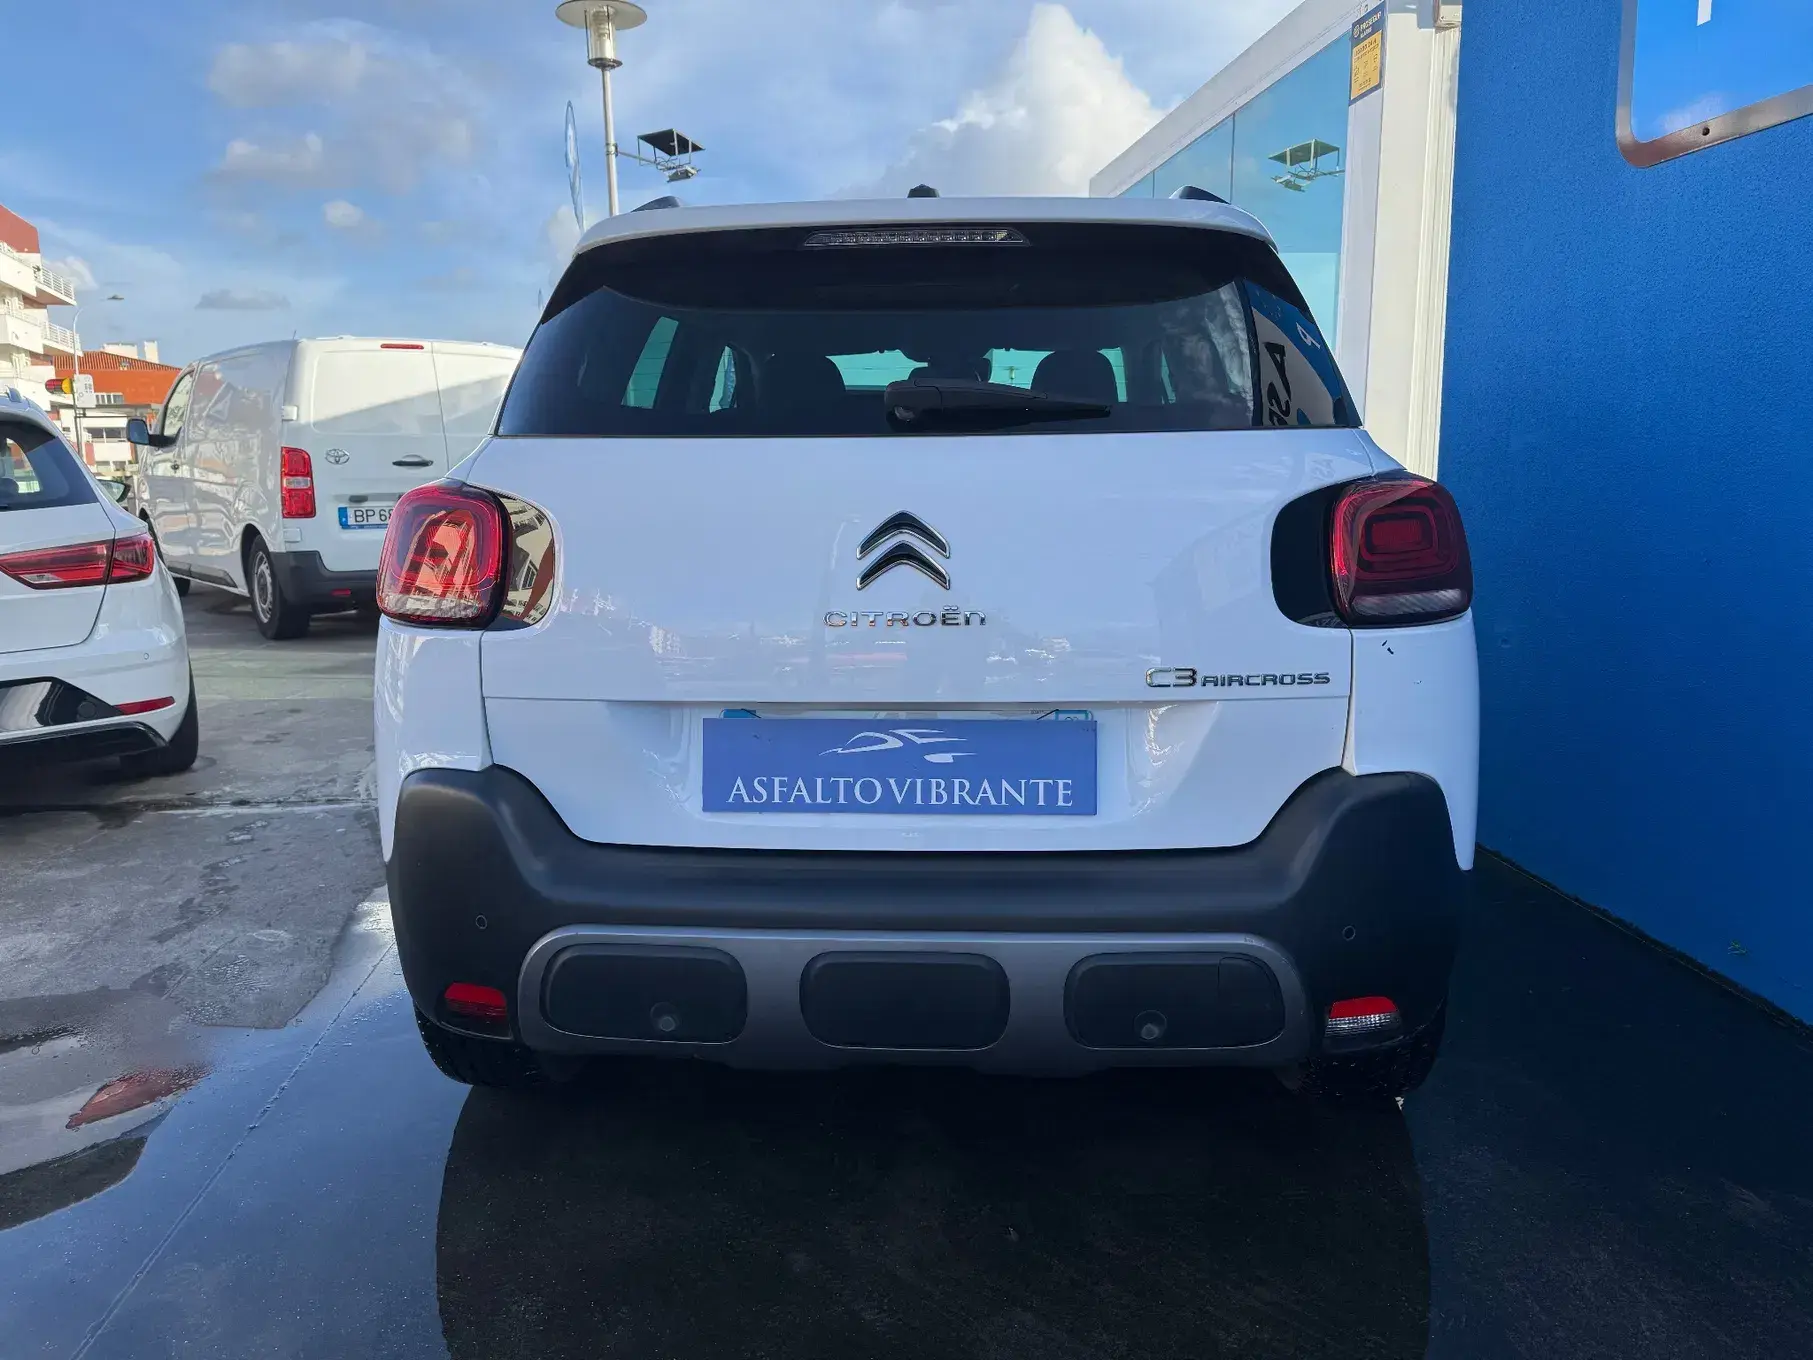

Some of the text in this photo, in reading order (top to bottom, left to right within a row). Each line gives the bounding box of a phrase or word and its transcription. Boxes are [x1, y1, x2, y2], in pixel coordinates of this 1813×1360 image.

[354, 509, 375, 523] BP
[1145, 667, 1331, 688] C3 AIRCROSS
